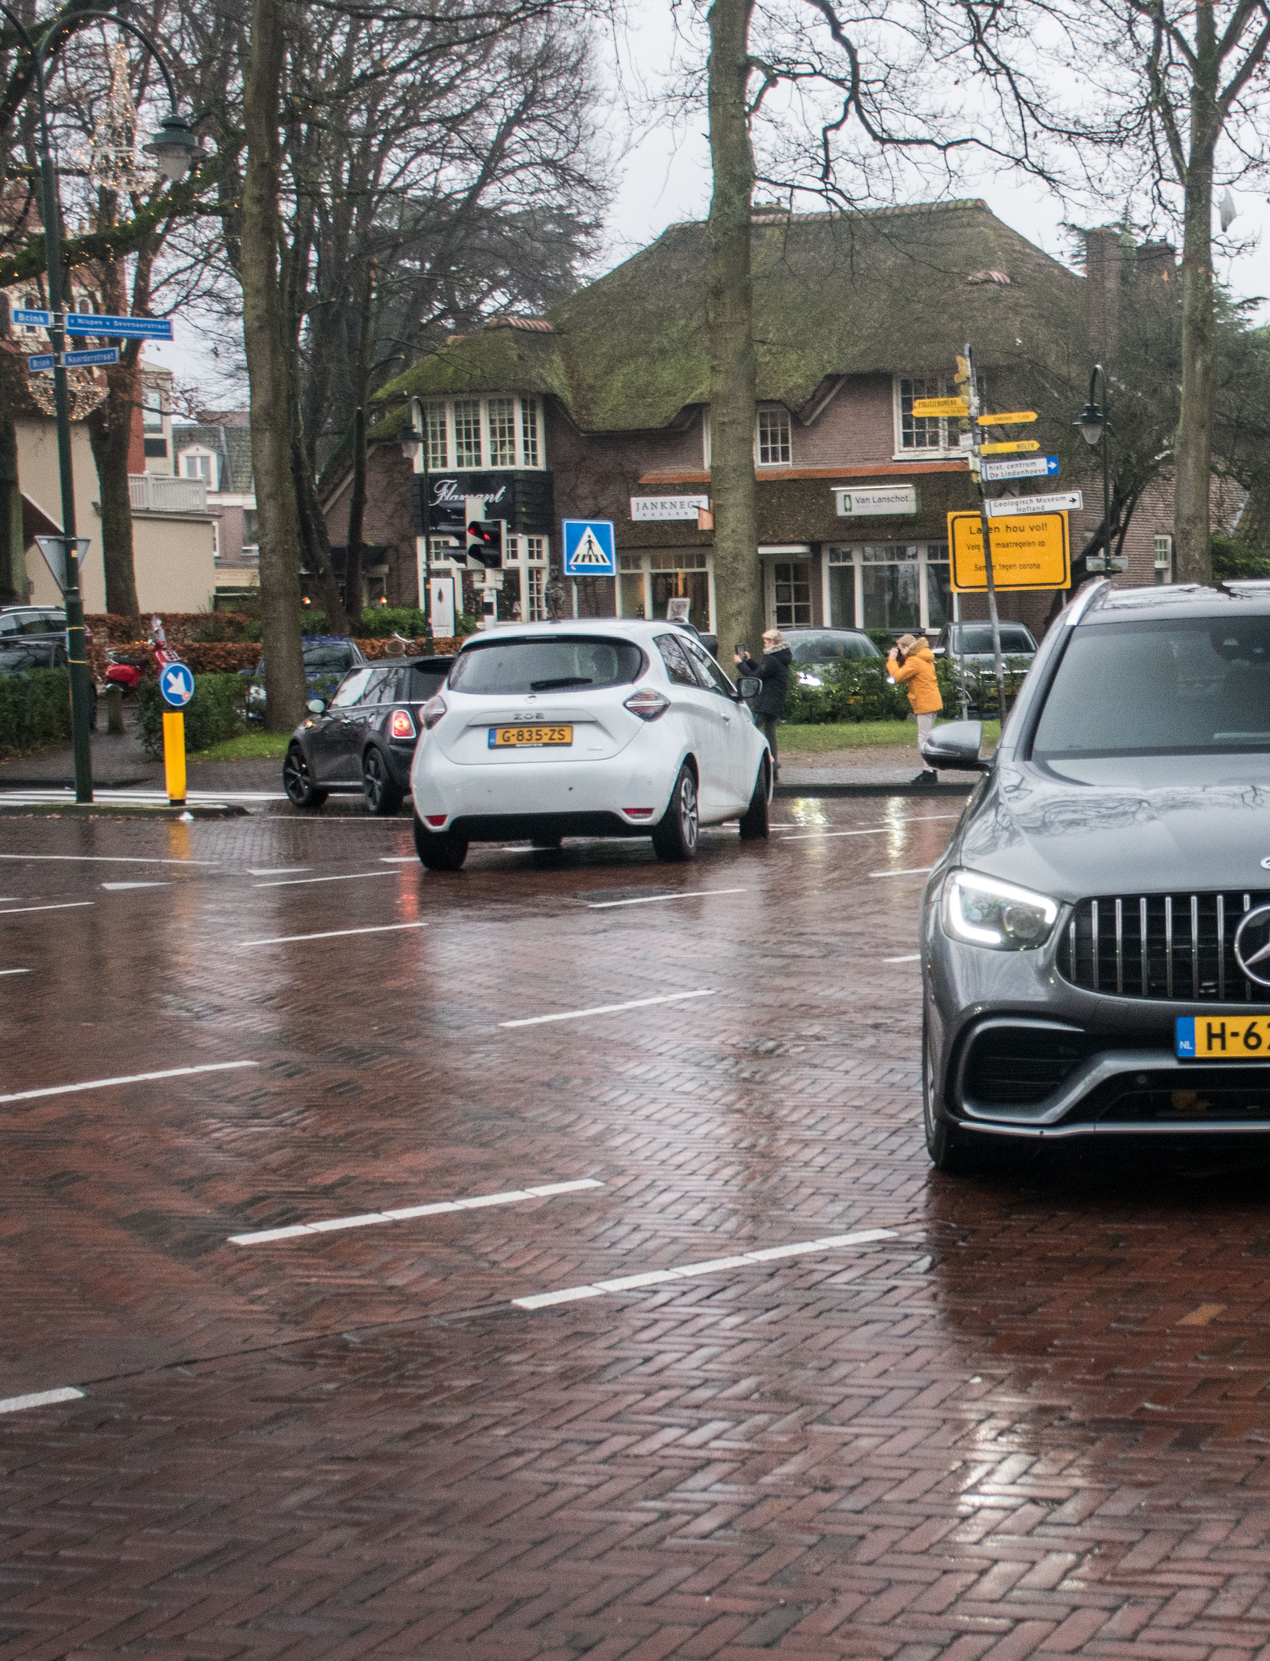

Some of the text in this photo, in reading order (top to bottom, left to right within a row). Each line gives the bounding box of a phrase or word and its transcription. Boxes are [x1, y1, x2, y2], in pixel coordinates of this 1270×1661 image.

[18, 312, 45, 323] Brink
[68, 352, 114, 363] Naarderstraat
[33, 359, 50, 368] Brink
[1007, 461, 1037, 469] centrum
[1001, 468, 1046, 478] Lindenhoeve
[855, 494, 909, 504] Van Lanschot
[994, 498, 1034, 508] Geologisch
[1016, 505, 1045, 513] Hofland
[969, 523, 1047, 535] Laen hou vol!
[967, 543, 981, 552] Volg
[995, 540, 1036, 550] maatregelen
[999, 563, 1018, 572] tegen
[1019, 562, 1041, 570] corona
[513, 713, 544, 721] ZOE
[502, 728, 565, 742] G-835-ZS
[1179, 1041, 1193, 1049] NL
